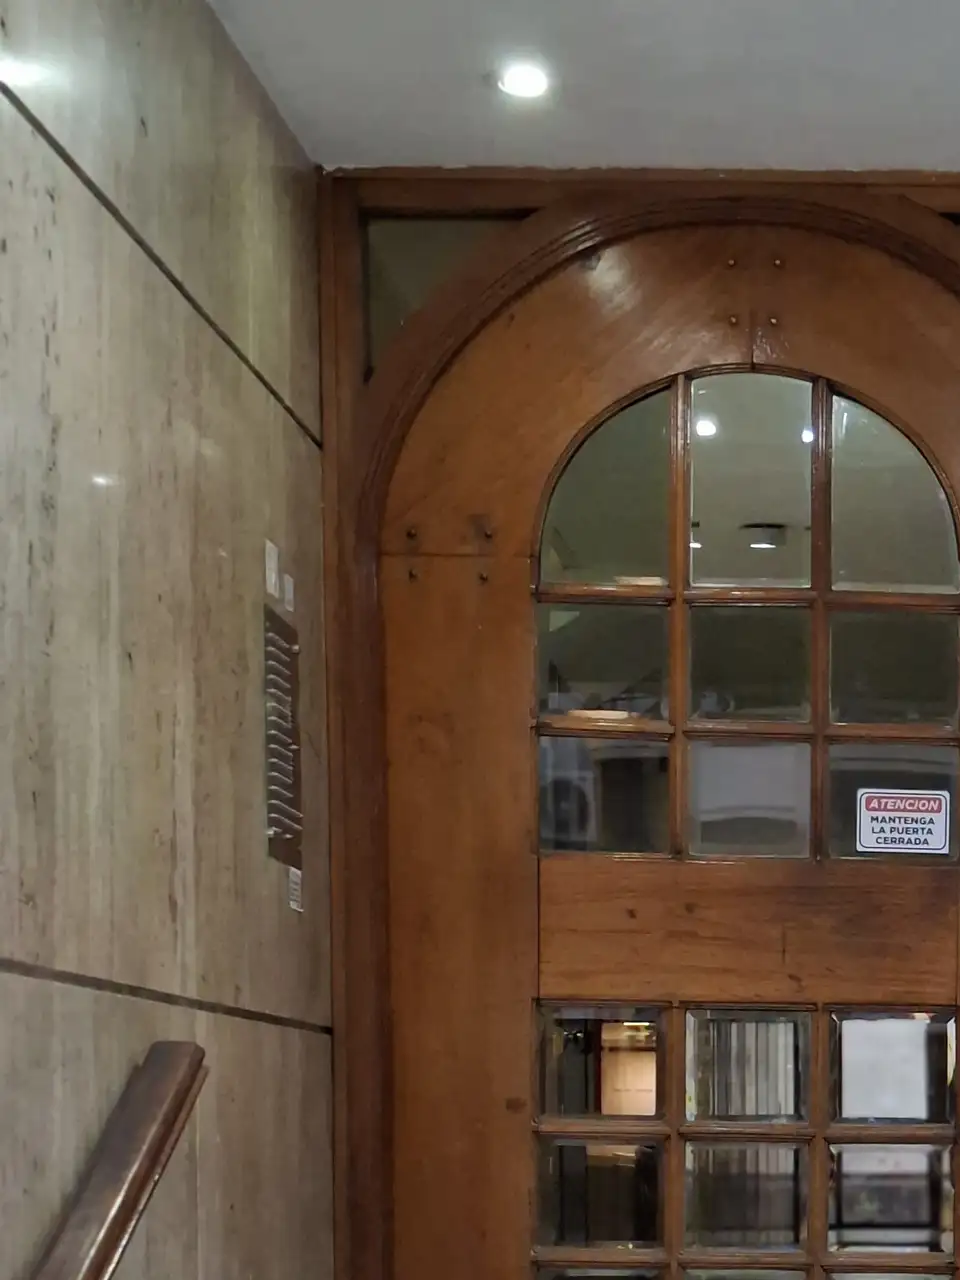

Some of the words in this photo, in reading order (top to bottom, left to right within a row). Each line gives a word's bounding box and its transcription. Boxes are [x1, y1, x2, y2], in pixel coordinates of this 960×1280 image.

[869, 799, 939, 811] ATENCION
[870, 816, 935, 825] MANTENGA
[889, 827, 934, 835] PUERTA
[876, 837, 930, 846] CERRADA
